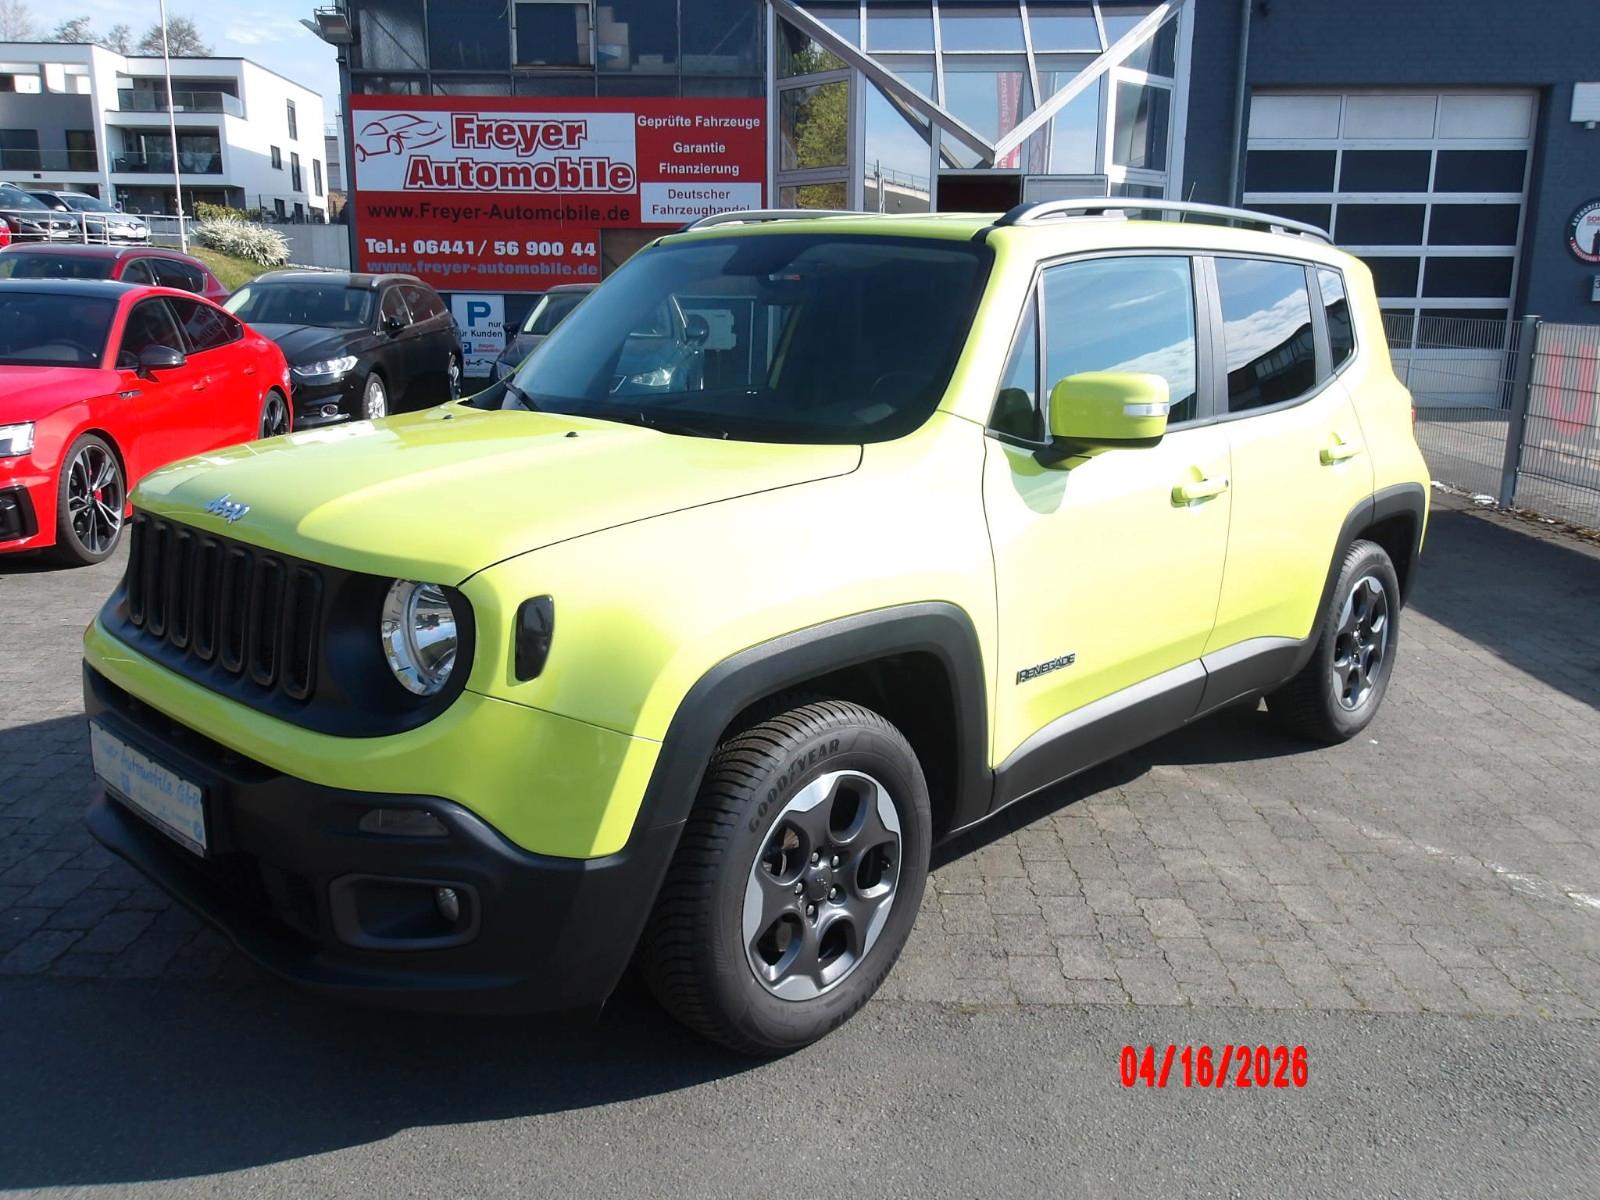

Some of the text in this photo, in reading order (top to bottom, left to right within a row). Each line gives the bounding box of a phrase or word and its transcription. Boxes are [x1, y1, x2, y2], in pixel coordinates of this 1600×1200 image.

[637, 115, 760, 129] Geprüfte Fahrzeuge
[450, 112, 587, 157] Freyer
[673, 142, 726, 153] Garantie
[403, 154, 636, 192] Automobile
[659, 163, 740, 176] Finanzierung
[668, 189, 730, 199] Deutscher
[367, 203, 631, 223] www.Freyer-Automobile.de
[365, 238, 597, 257] Tel.: 06441/ 56 900 44
[367, 260, 598, 277] www.freyer-automobile.de
[467, 301, 491, 327] P
[471, 330, 502, 338] Kunden
[1015, 653, 1075, 685] RENEGADE
[749, 738, 840, 833] GOODYEAR
